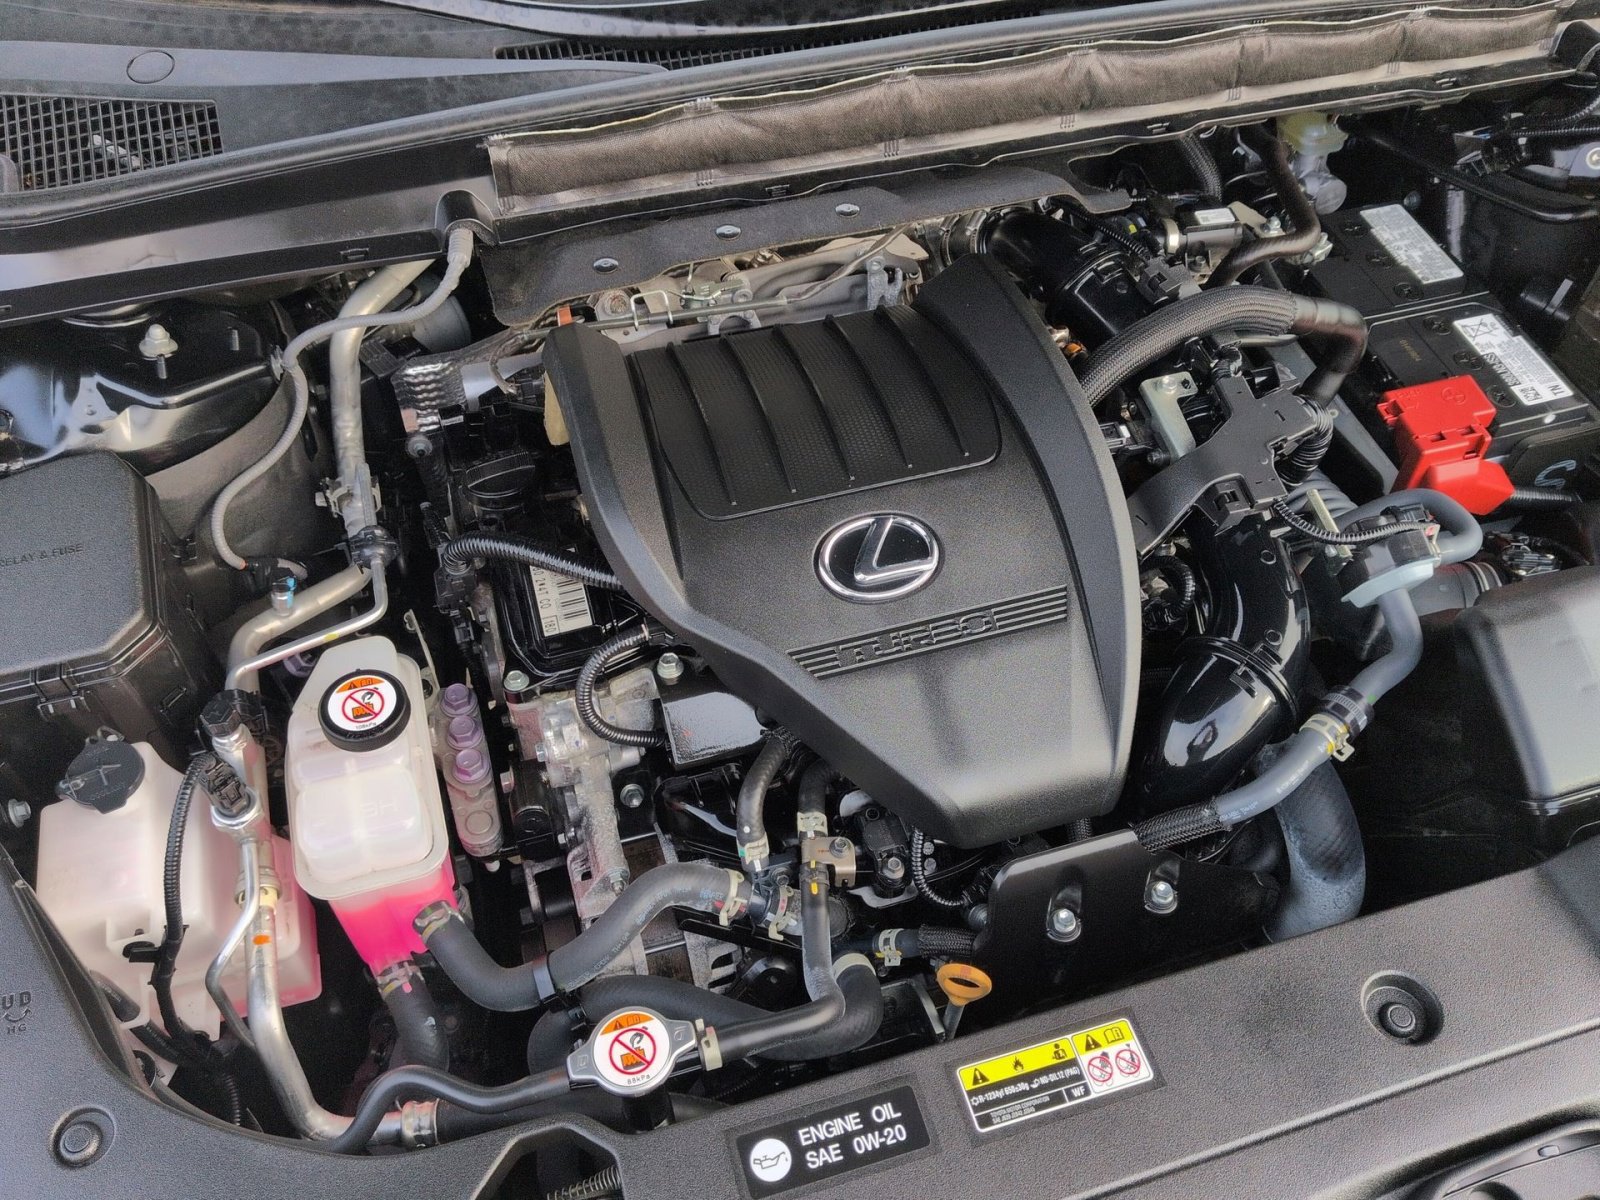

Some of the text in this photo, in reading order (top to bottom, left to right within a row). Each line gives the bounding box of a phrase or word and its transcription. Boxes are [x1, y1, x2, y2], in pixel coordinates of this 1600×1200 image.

[40, 551, 48, 560] &
[52, 543, 84, 558] FUSE
[836, 610, 998, 666] TURBO
[1065, 1066, 1081, 1079] (PAG)
[1071, 1086, 1086, 1097] WF
[798, 1102, 902, 1146] ENGINE OIL
[805, 1124, 907, 1169] SAE 0W-20
